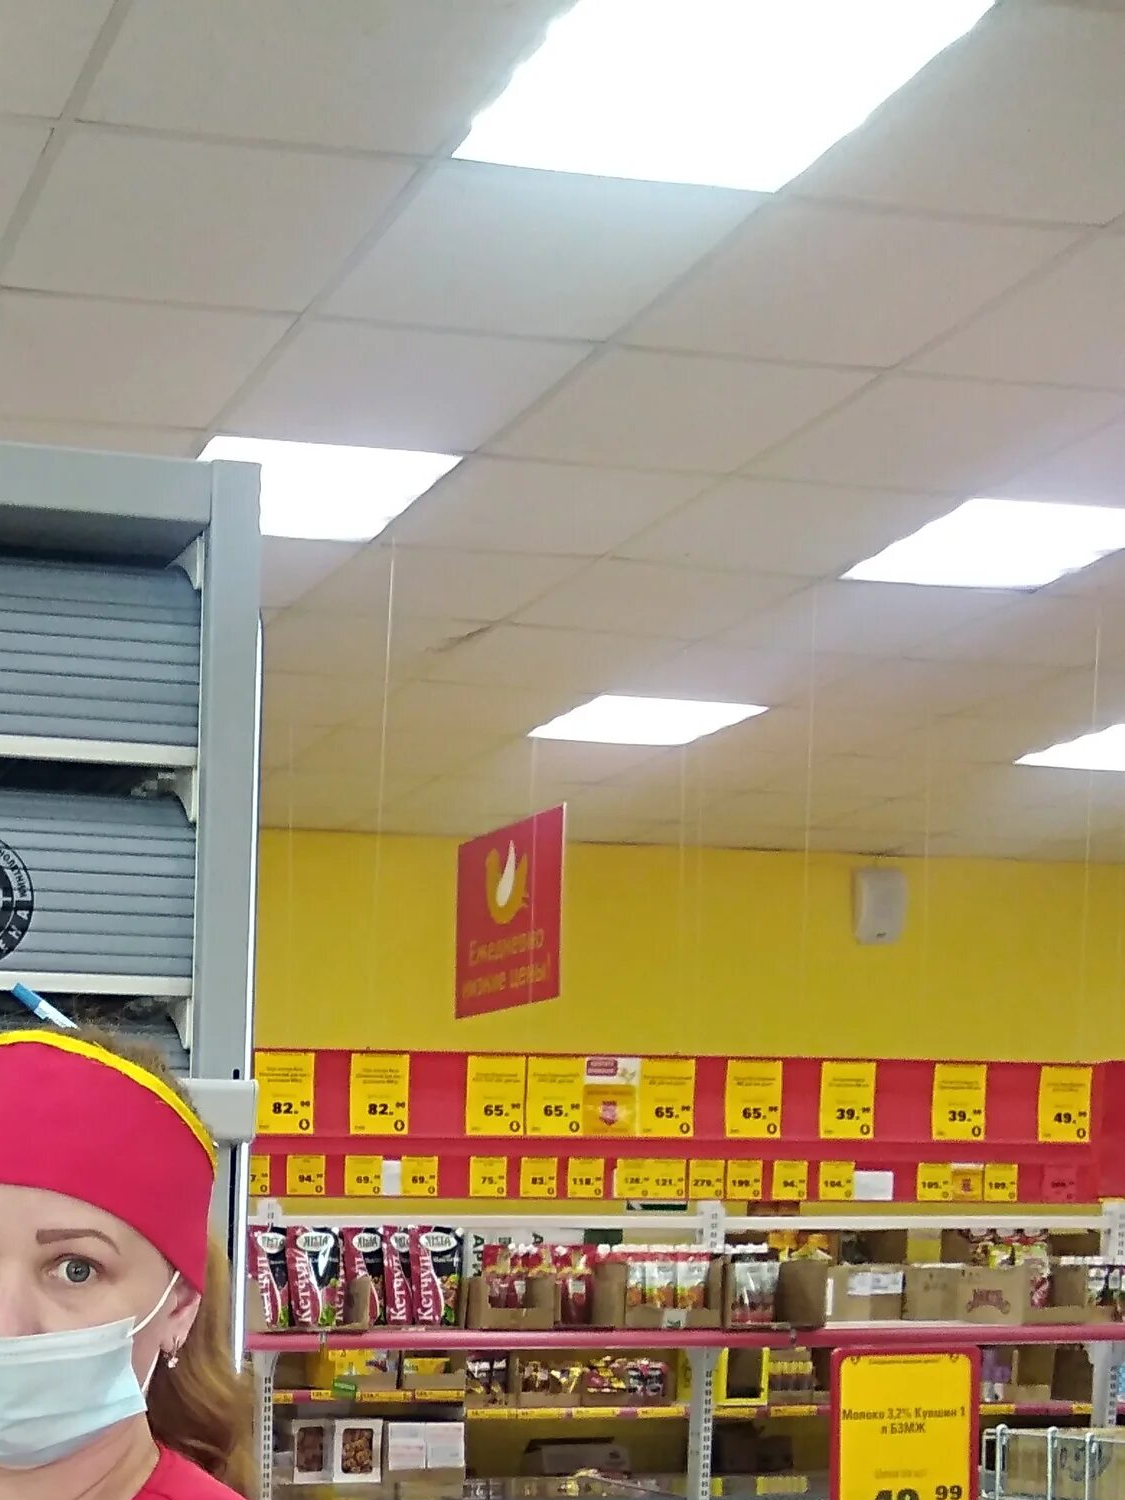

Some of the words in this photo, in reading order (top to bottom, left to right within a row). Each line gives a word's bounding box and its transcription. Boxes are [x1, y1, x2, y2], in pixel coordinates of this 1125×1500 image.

[417, 1255, 434, 1321] Кетчуп
[842, 1408, 885, 1421] Молоко
[914, 1408, 958, 1421] Кувшин
[890, 1421, 926, 1435] БЗМЖ
